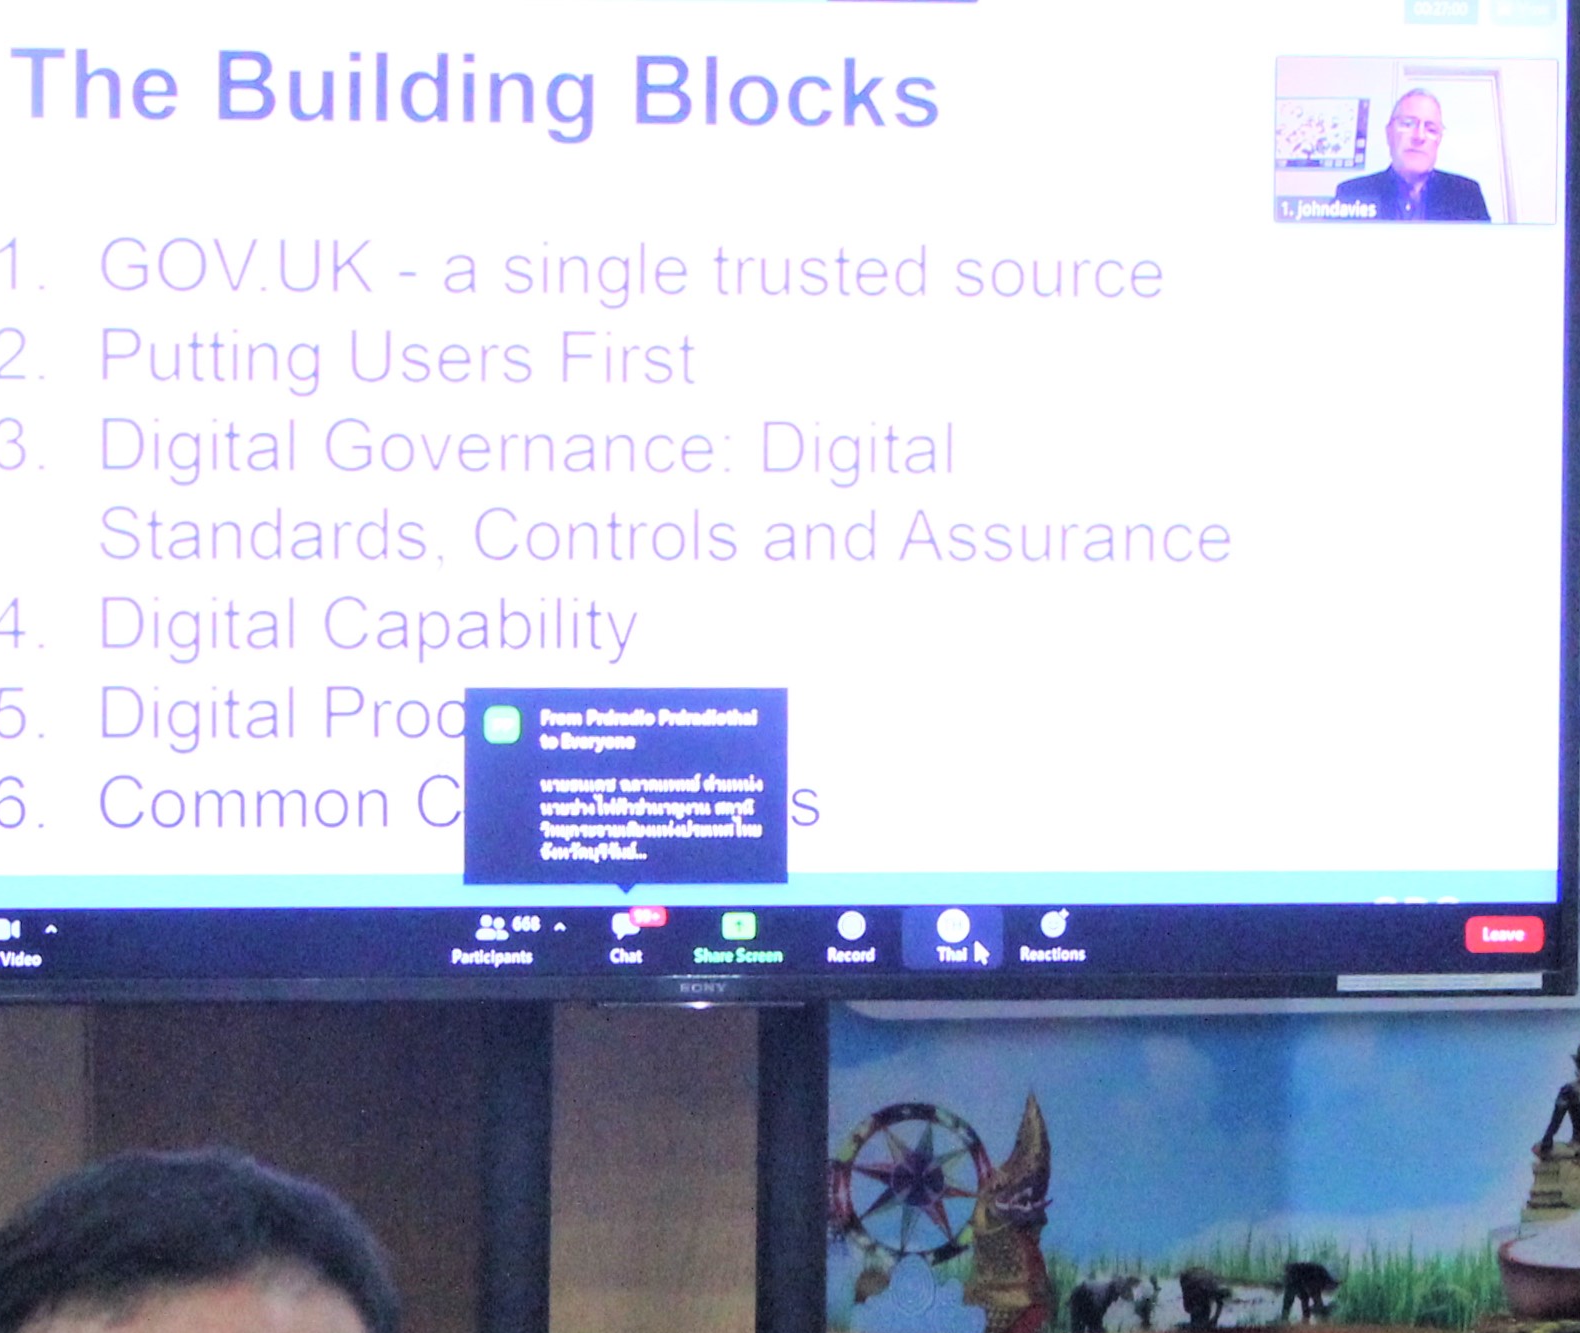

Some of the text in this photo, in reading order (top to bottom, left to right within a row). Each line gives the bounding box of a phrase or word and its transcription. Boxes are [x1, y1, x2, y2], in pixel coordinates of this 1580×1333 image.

[11, 47, 938, 144] The Building Blocks
[1295, 199, 1377, 221] johndavies
[0, 238, 44, 289] 1.
[101, 237, 371, 292] GOV.UK
[444, 255, 475, 293] a
[505, 243, 687, 309] single
[714, 245, 925, 296] trusted
[956, 259, 1162, 298] source
[103, 328, 319, 397] Putting
[352, 330, 532, 383] Users
[563, 331, 694, 384] First
[102, 418, 294, 486] Digital
[326, 418, 729, 473] Governance:
[764, 422, 951, 488] Digital
[101, 506, 1230, 569] Standards, Controls and Assurance
[102, 597, 294, 664] Digital
[325, 596, 637, 664] Capability
[102, 686, 293, 754] Digital
[540, 709, 583, 726] From
[539, 732, 636, 753] to Everyone
[100, 775, 388, 829] Common
[1482, 927, 1525, 942] Leave
[0, 951, 42, 966] Video
[452, 949, 533, 967] Participants
[610, 948, 642, 963] Chat
[695, 948, 782, 962] Share Screen
[828, 947, 875, 962] Record
[937, 946, 967, 961] Thai
[1021, 946, 1085, 961] Reactions
[680, 983, 726, 993] SONY
